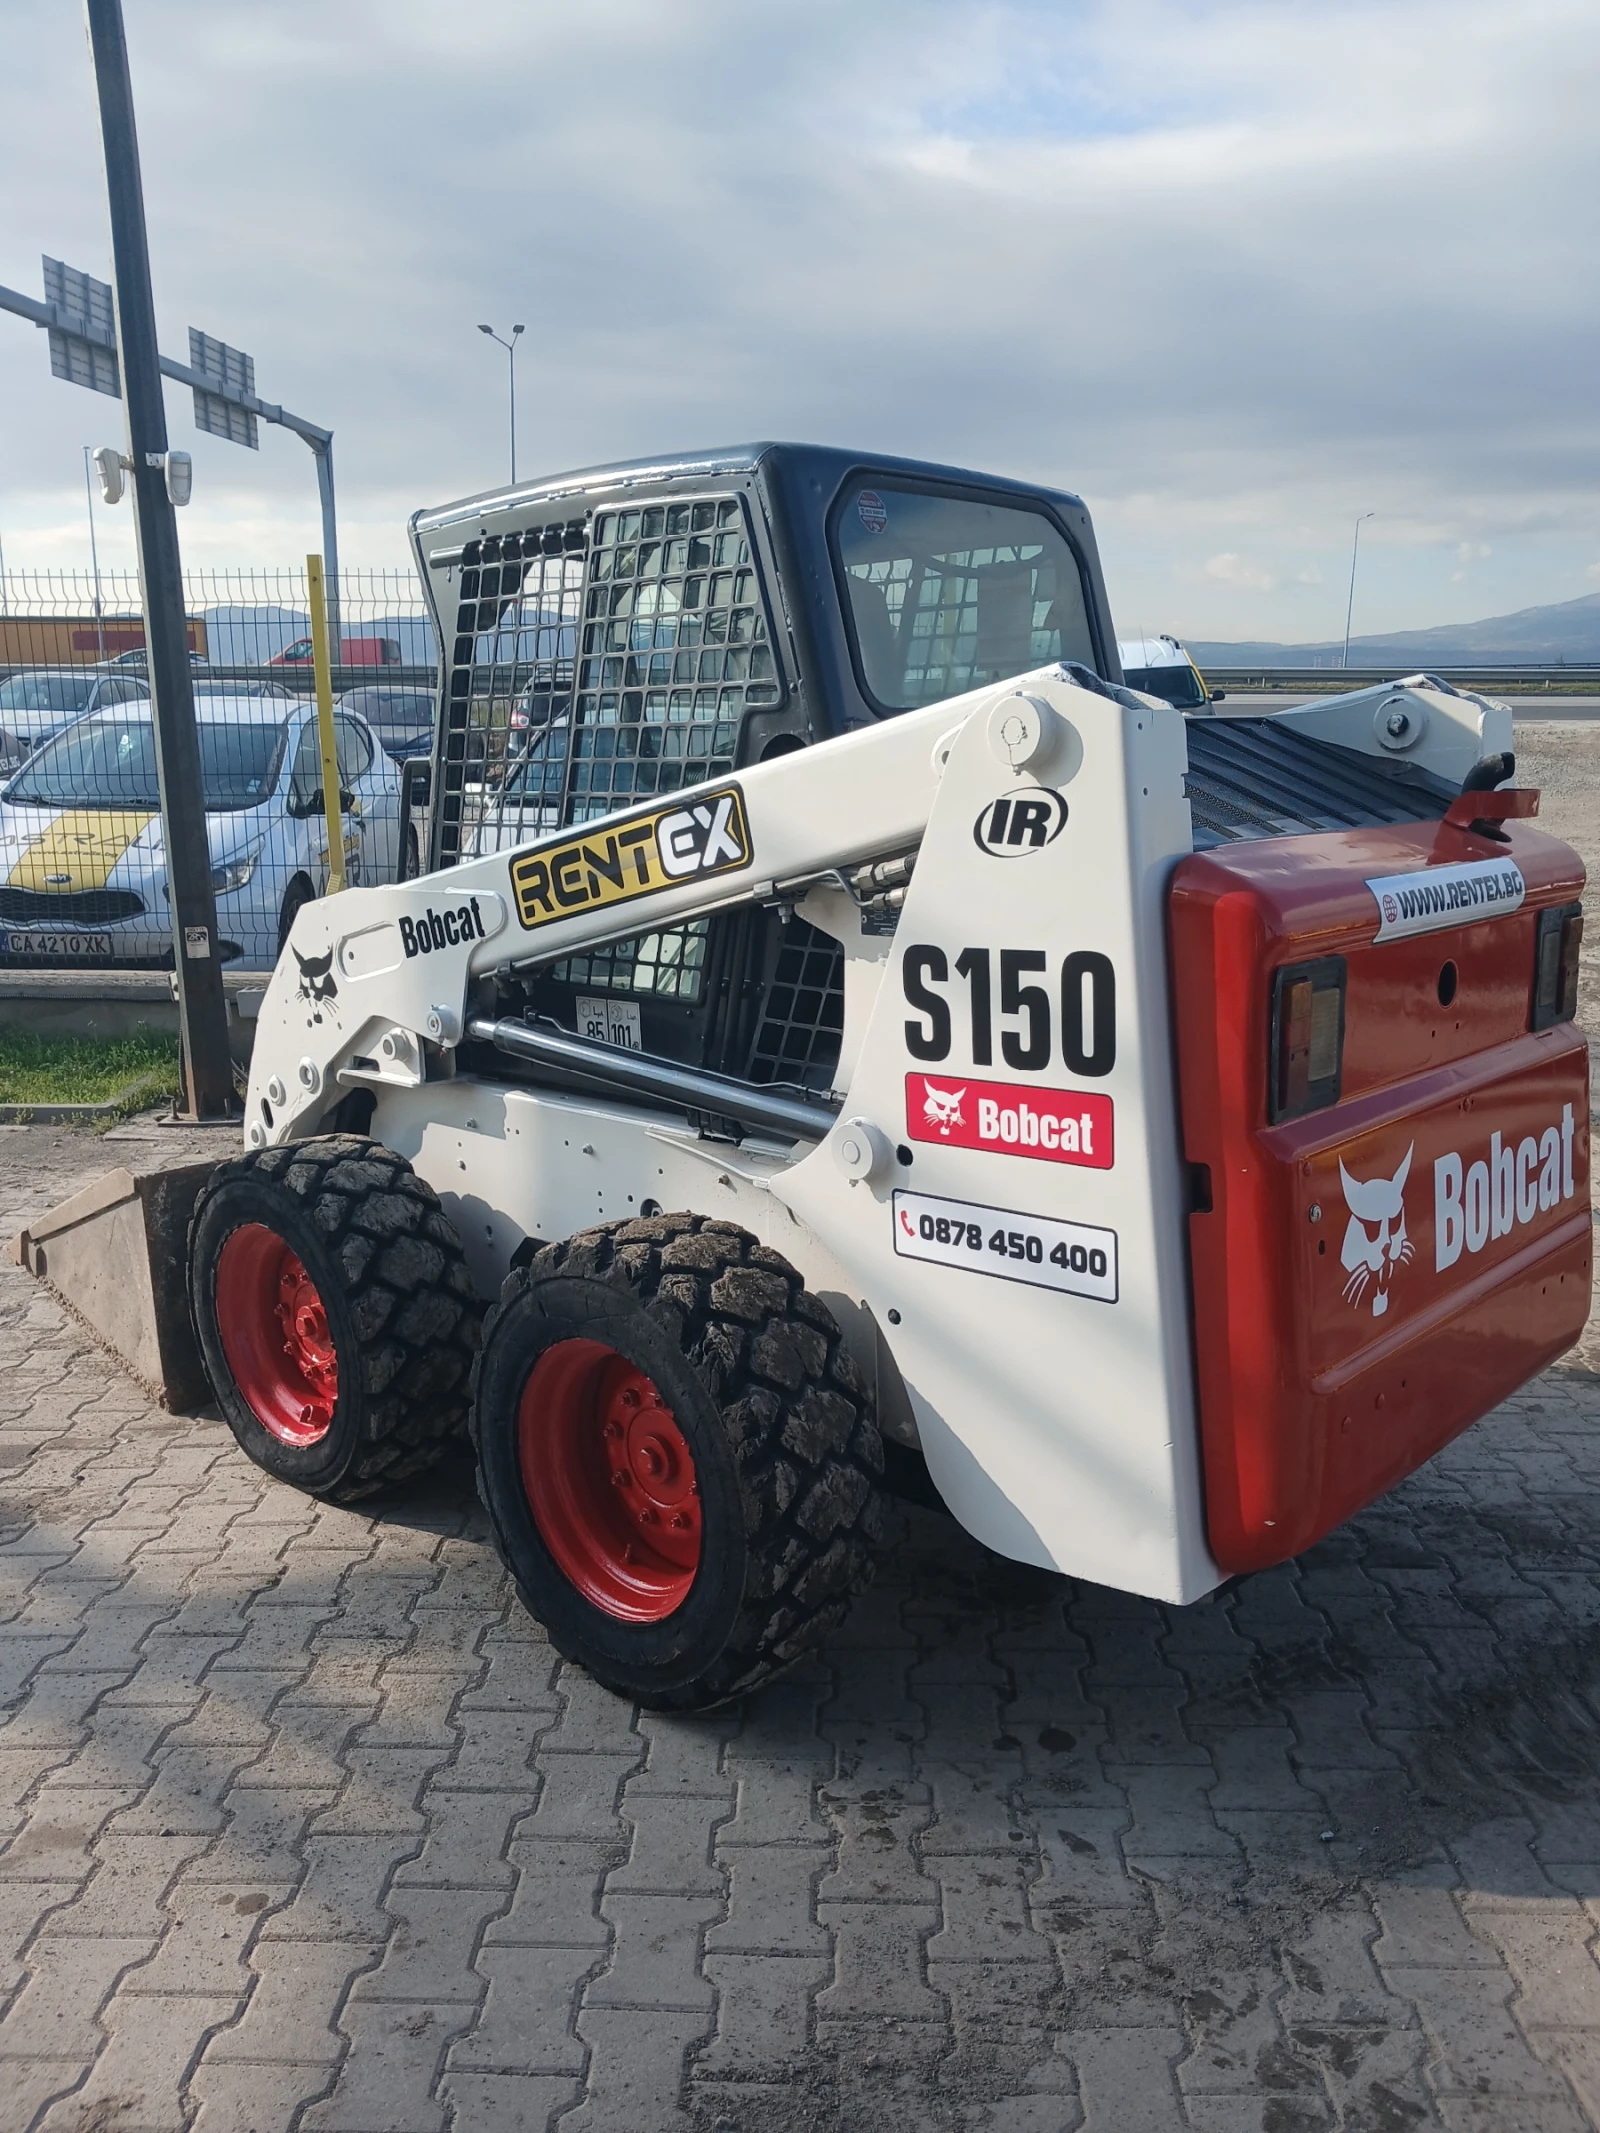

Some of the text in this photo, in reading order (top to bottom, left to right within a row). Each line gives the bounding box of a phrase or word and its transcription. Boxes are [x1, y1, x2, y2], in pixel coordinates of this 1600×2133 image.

[987, 799, 1052, 847] IR
[517, 798, 742, 919] RENTEX
[1396, 871, 1522, 919] WWW.RENTEX.BG
[11, 935, 107, 953] CA 4210 XK
[399, 896, 486, 959] Bobcat
[587, 1020, 605, 1040] 85
[611, 1023, 631, 1049] 101
[903, 944, 1116, 1077] S150
[978, 1098, 1094, 1155] Bobcat
[1434, 1102, 1575, 1274] Bobcat
[919, 1214, 1107, 1277] 0878 450 400
